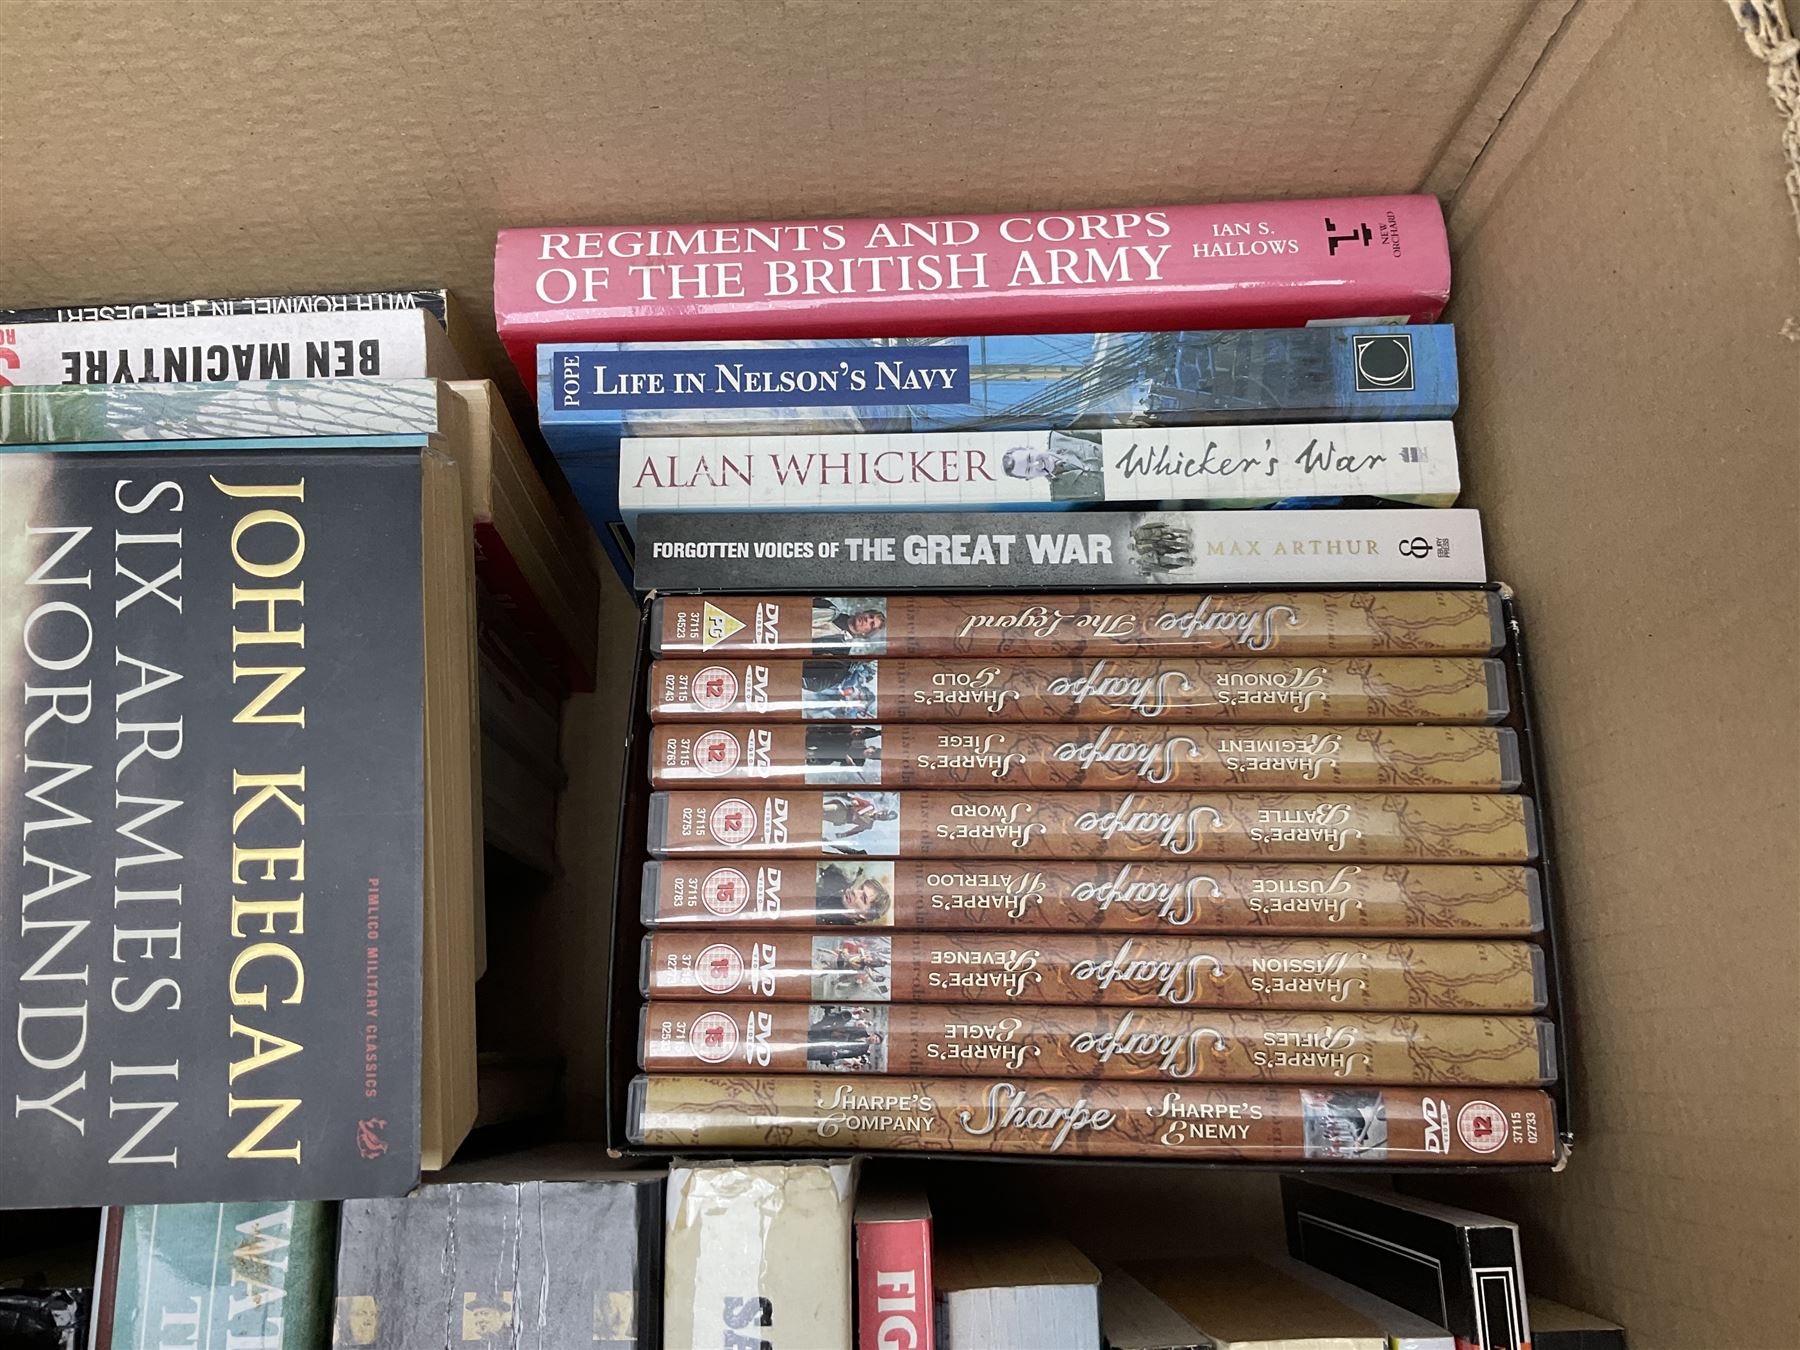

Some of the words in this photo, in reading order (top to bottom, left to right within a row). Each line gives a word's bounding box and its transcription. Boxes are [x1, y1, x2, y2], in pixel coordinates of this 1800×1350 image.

[537, 224, 846, 260] REGIMENTS
[864, 220, 980, 249] AND
[999, 211, 1170, 244] CORPS
[1212, 223, 1252, 237] IAN
[1257, 222, 1275, 236] S.
[1380, 223, 1390, 245] NEW
[1387, 211, 1401, 258] ORCHARD
[1193, 239, 1299, 258] HALLOWS
[535, 265, 610, 303] OF
[628, 262, 745, 300] THE
[764, 253, 988, 296] BRITISH
[1008, 244, 1172, 285] ARMY
[61, 342, 290, 385] MACINTYRE
[307, 338, 380, 377] BEN
[563, 354, 580, 406] POPE
[593, 364, 664, 395] LIFE
[673, 373, 705, 394] IN
[714, 361, 866, 393] NELSON'S
[875, 360, 957, 390] NAVY
[632, 454, 755, 488] ALAN
[769, 450, 996, 487] WHICKER
[1116, 438, 1280, 479] Whicker's
[1295, 438, 1387, 474] War
[115, 479, 184, 618] SIX
[653, 542, 749, 559] FORGOTTEN
[754, 542, 814, 559] VOICES
[818, 541, 839, 558] OF
[845, 537, 896, 562] THE
[903, 534, 1019, 566] GREAT
[1025, 533, 1112, 565] WAR
[1206, 539, 1261, 556] MAX
[1273, 539, 1380, 556] ARTHUR
[210, 474, 306, 728] JOHN
[677, 612, 686, 639] 04523
[690, 612, 699, 639] 37115
[708, 616, 726, 639] PG
[763, 603, 779, 650] DVD
[959, 606, 1075, 637] Legend
[1075, 613, 1136, 637] The
[1155, 595, 1297, 650] Sharpe
[665, 674, 675, 702] 02743
[679, 674, 688, 702] 37115
[706, 678, 724, 698] 12
[752, 665, 768, 714] DVD
[932, 667, 1000, 689] GOLD
[1047, 659, 1193, 717] Sharpe
[1216, 667, 1327, 688] HONOUR
[914, 689, 1020, 713] SHARPE'S
[1218, 690, 1327, 713] SHARPE'S
[667, 738, 677, 766] 02763
[680, 738, 690, 766] 37115
[708, 742, 726, 763] 12
[756, 730, 772, 778] DVD
[938, 733, 1004, 754] SIEGE
[1053, 726, 1199, 784] Sharpe
[1218, 733, 1343, 756] REGIMENT
[917, 753, 1026, 778] SHARPE'S
[1226, 756, 1337, 781] SHARPE'S
[682, 807, 692, 836] 02753
[696, 807, 706, 836] 37115
[724, 811, 742, 832] 12
[772, 797, 789, 846] DVD
[950, 802, 1032, 824] SWORD
[1074, 793, 1226, 854] Sharpe
[1258, 803, 1351, 826] BATTLE
[15, 521, 93, 1136] NORMANDY
[110, 645, 184, 1013] ARMIES
[936, 823, 1047, 847] SHARPE'S
[1250, 825, 1362, 852] SHARPE'S
[674, 878, 684, 907] 02783
[688, 878, 698, 907] 37115
[716, 881, 734, 902] 15
[765, 867, 782, 920] DVD
[927, 872, 1047, 894] WATERLOO
[1071, 863, 1223, 926] Sharpe
[1252, 866, 1362, 896] JUSTICE
[367, 877, 380, 940] PIMLICO
[931, 893, 1043, 919] SHARPE'S
[1249, 896, 1363, 922] SHARPE'S
[227, 766, 306, 1165] KEEGAN
[710, 958, 729, 978] 15
[761, 943, 776, 997] DVD
[931, 949, 1040, 972] REVENGE
[1071, 938, 1223, 1004] Sharpe
[1252, 951, 1367, 976] MISSION
[366, 946, 379, 1018] MILITARY
[928, 971, 1042, 997] SHARPE'S
[1251, 977, 1365, 1003] SHARPE'S
[705, 1026, 724, 1048] 15
[755, 1011, 772, 1067] DVD
[944, 1017, 1023, 1042] EAGLE
[1263, 1026, 1359, 1050] RIFLES
[927, 1043, 1041, 1070] SHARPE'S
[1070, 1010, 1225, 1078] Sharpe
[365, 1024, 378, 1098] CLASSICS
[1253, 1051, 1370, 1078] SHARPE'S
[818, 1084, 932, 1112] SHARPE'S
[1147, 1092, 1263, 1120] SHARPE'S
[108, 1059, 179, 1168] IN
[816, 1112, 935, 1138] COMPANY
[959, 1082, 1116, 1152] Sharpe
[1422, 1097, 1441, 1153] DVD
[1473, 1116, 1493, 1138] 12
[1511, 1112, 1523, 1143] 37115
[1526, 1112, 1538, 1143] 02733
[1160, 1120, 1250, 1146] ENEMY
